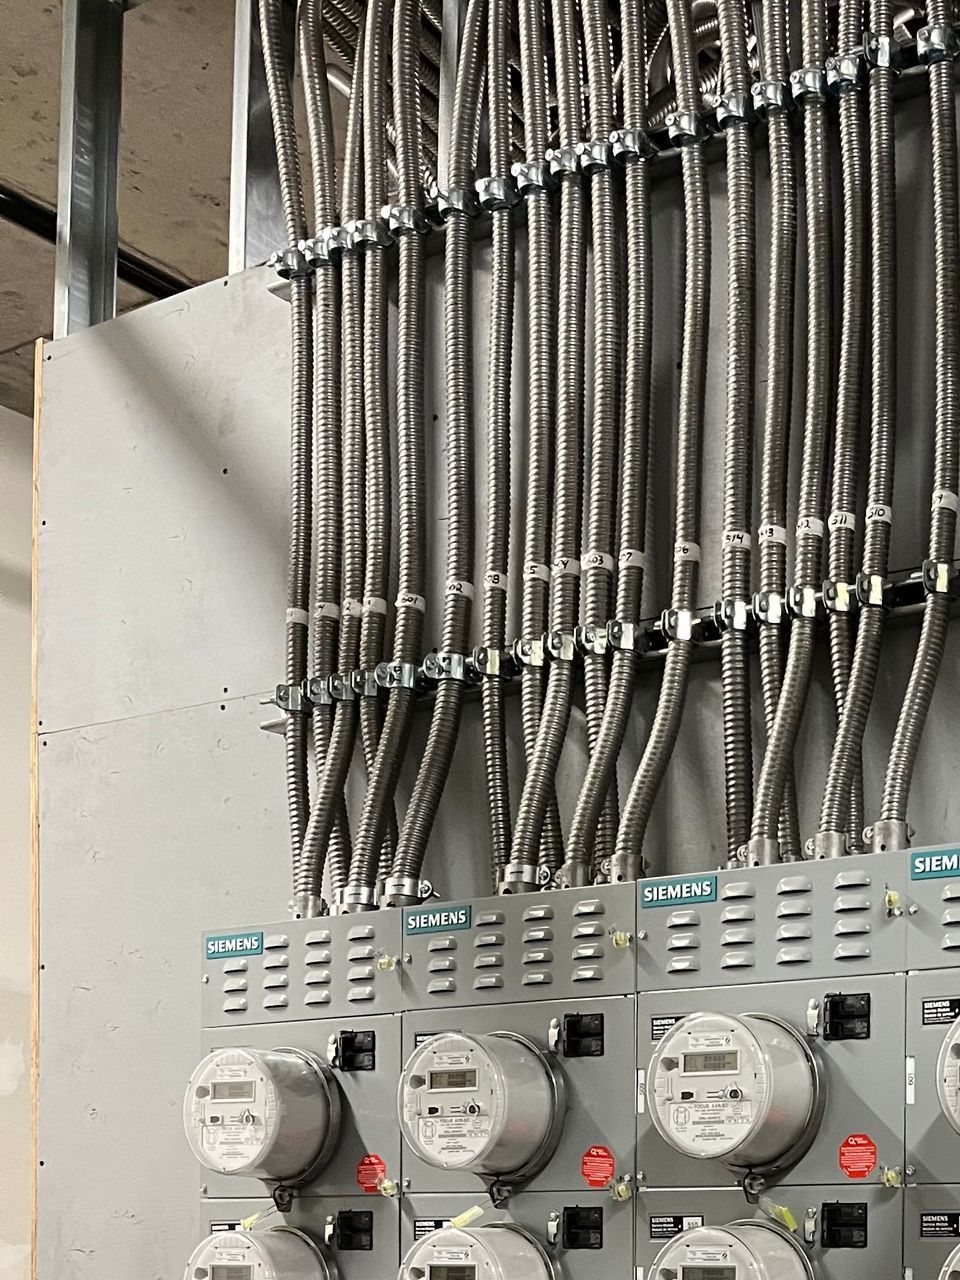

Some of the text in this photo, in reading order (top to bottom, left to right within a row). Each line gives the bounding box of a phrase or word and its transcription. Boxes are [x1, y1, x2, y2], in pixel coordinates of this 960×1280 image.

[643, 880, 712, 902] SIEMENS
[407, 910, 467, 929] SIEMENS
[207, 936, 259, 954] SIEMENS
[923, 1000, 950, 1009] SIEMENS
